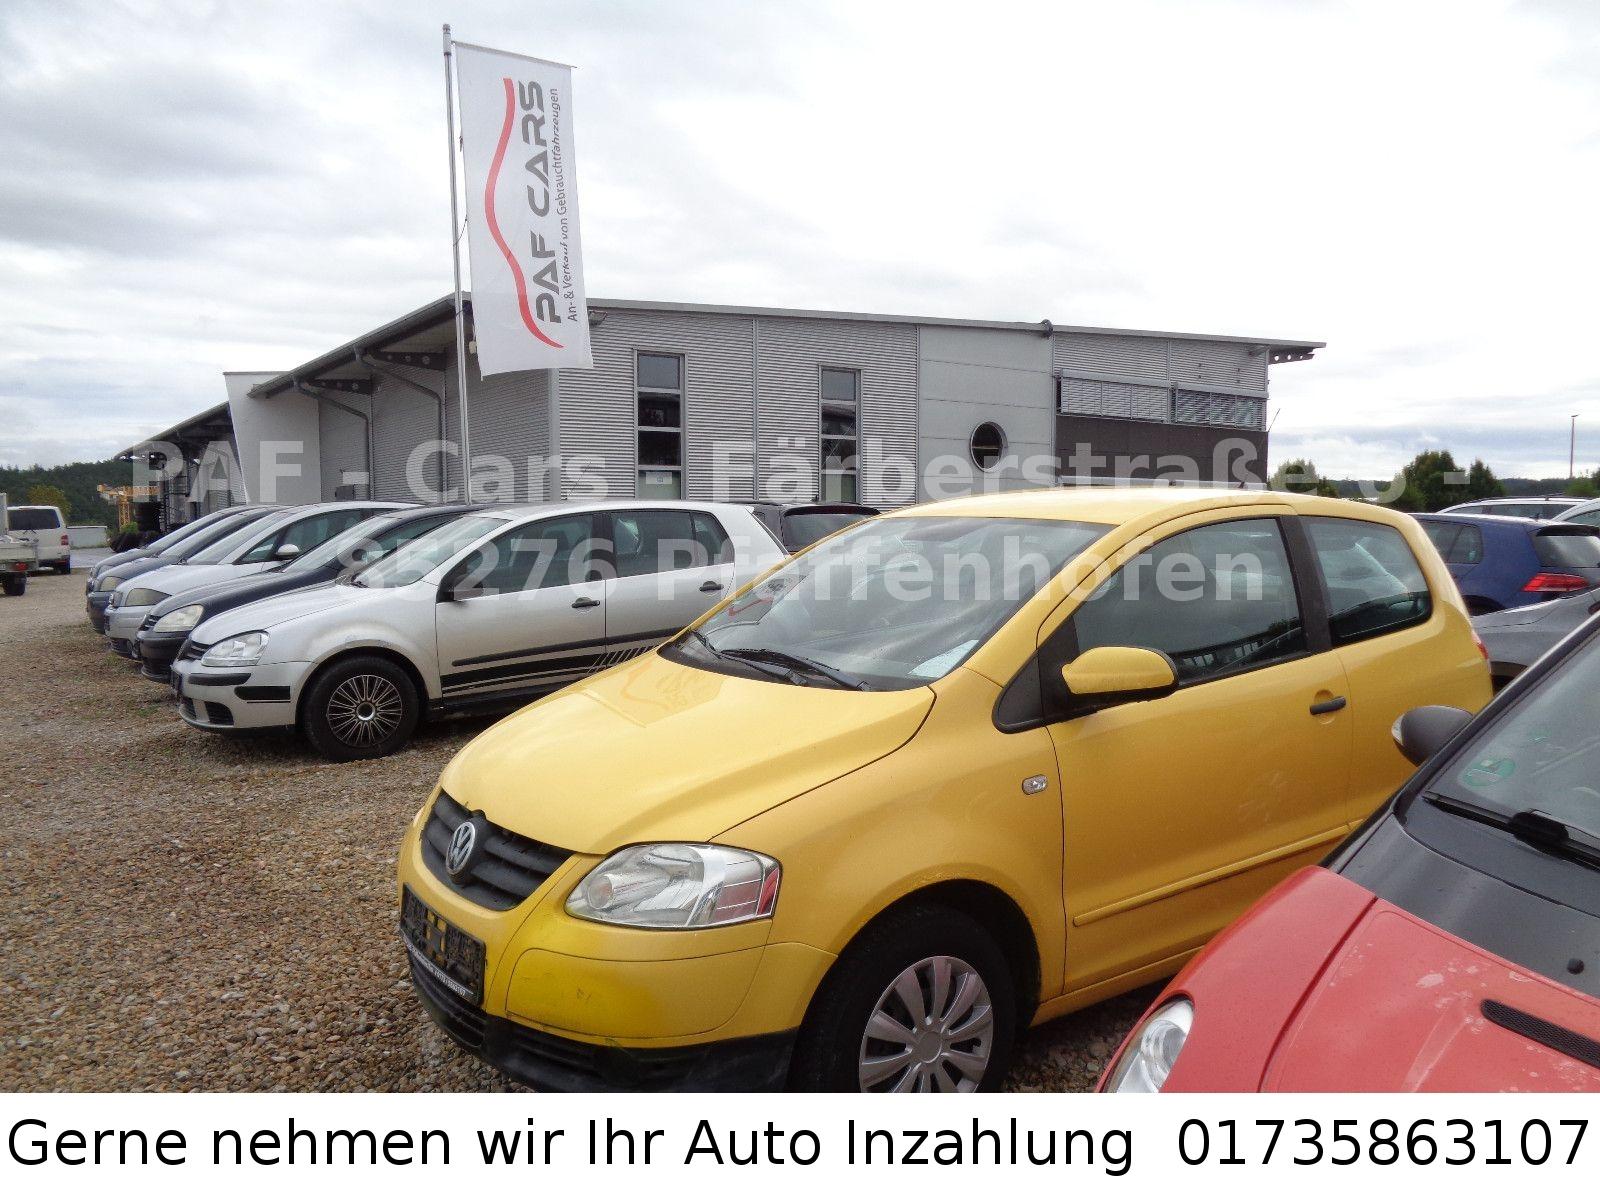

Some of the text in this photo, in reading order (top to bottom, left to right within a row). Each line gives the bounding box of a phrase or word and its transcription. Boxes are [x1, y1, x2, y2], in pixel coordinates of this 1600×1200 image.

[518, 79, 562, 324] PAF CARS
[550, 88, 578, 322] An- & Verkauf von Gebrauchtfahrzeugen
